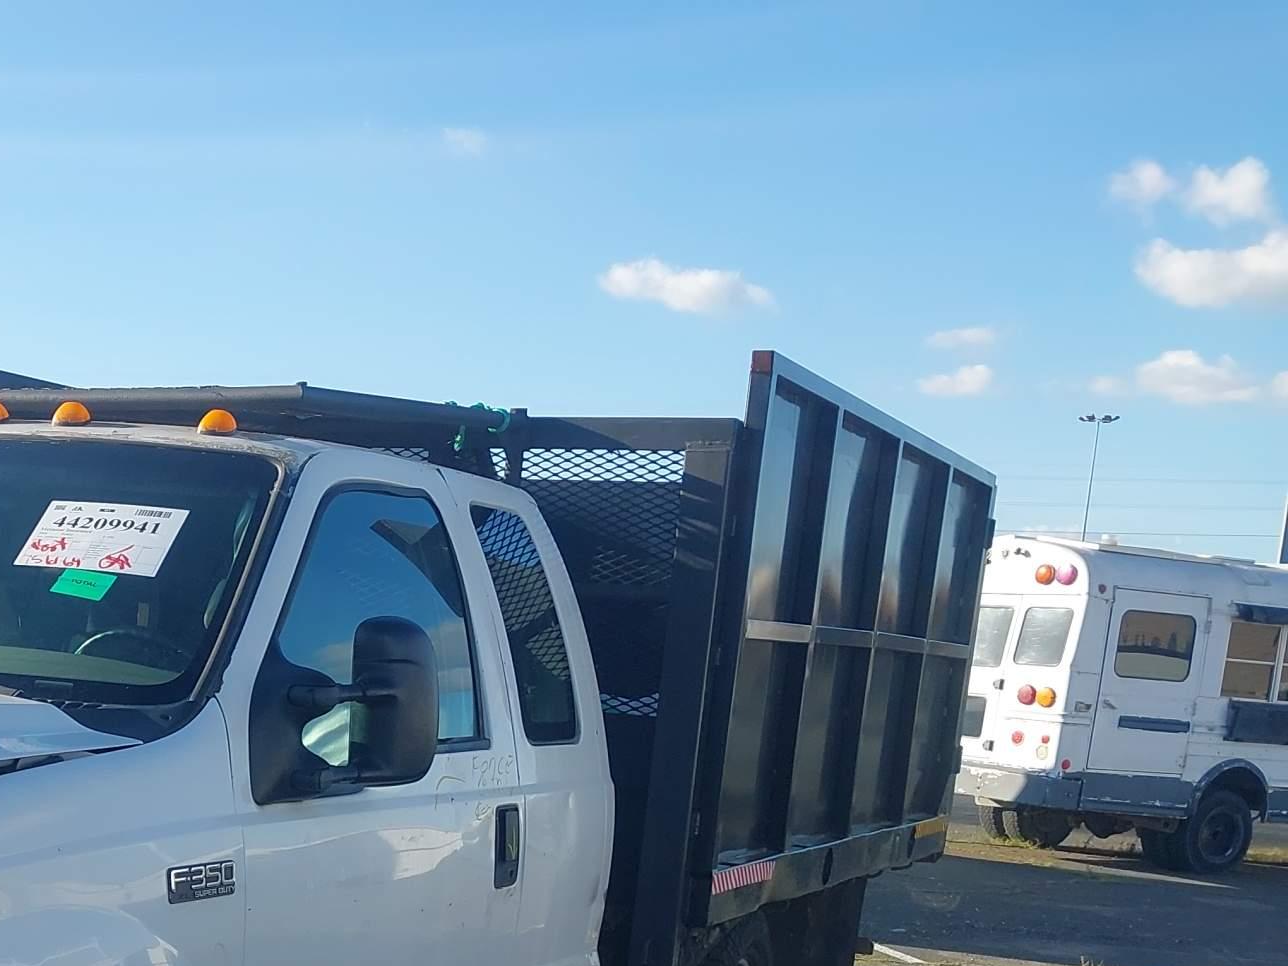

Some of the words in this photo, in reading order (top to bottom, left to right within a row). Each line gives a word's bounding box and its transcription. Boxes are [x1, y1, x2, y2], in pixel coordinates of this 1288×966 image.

[53, 516, 161, 534] 44209941
[195, 888, 217, 897] SUPER
[218, 885, 235, 894] DUTY
